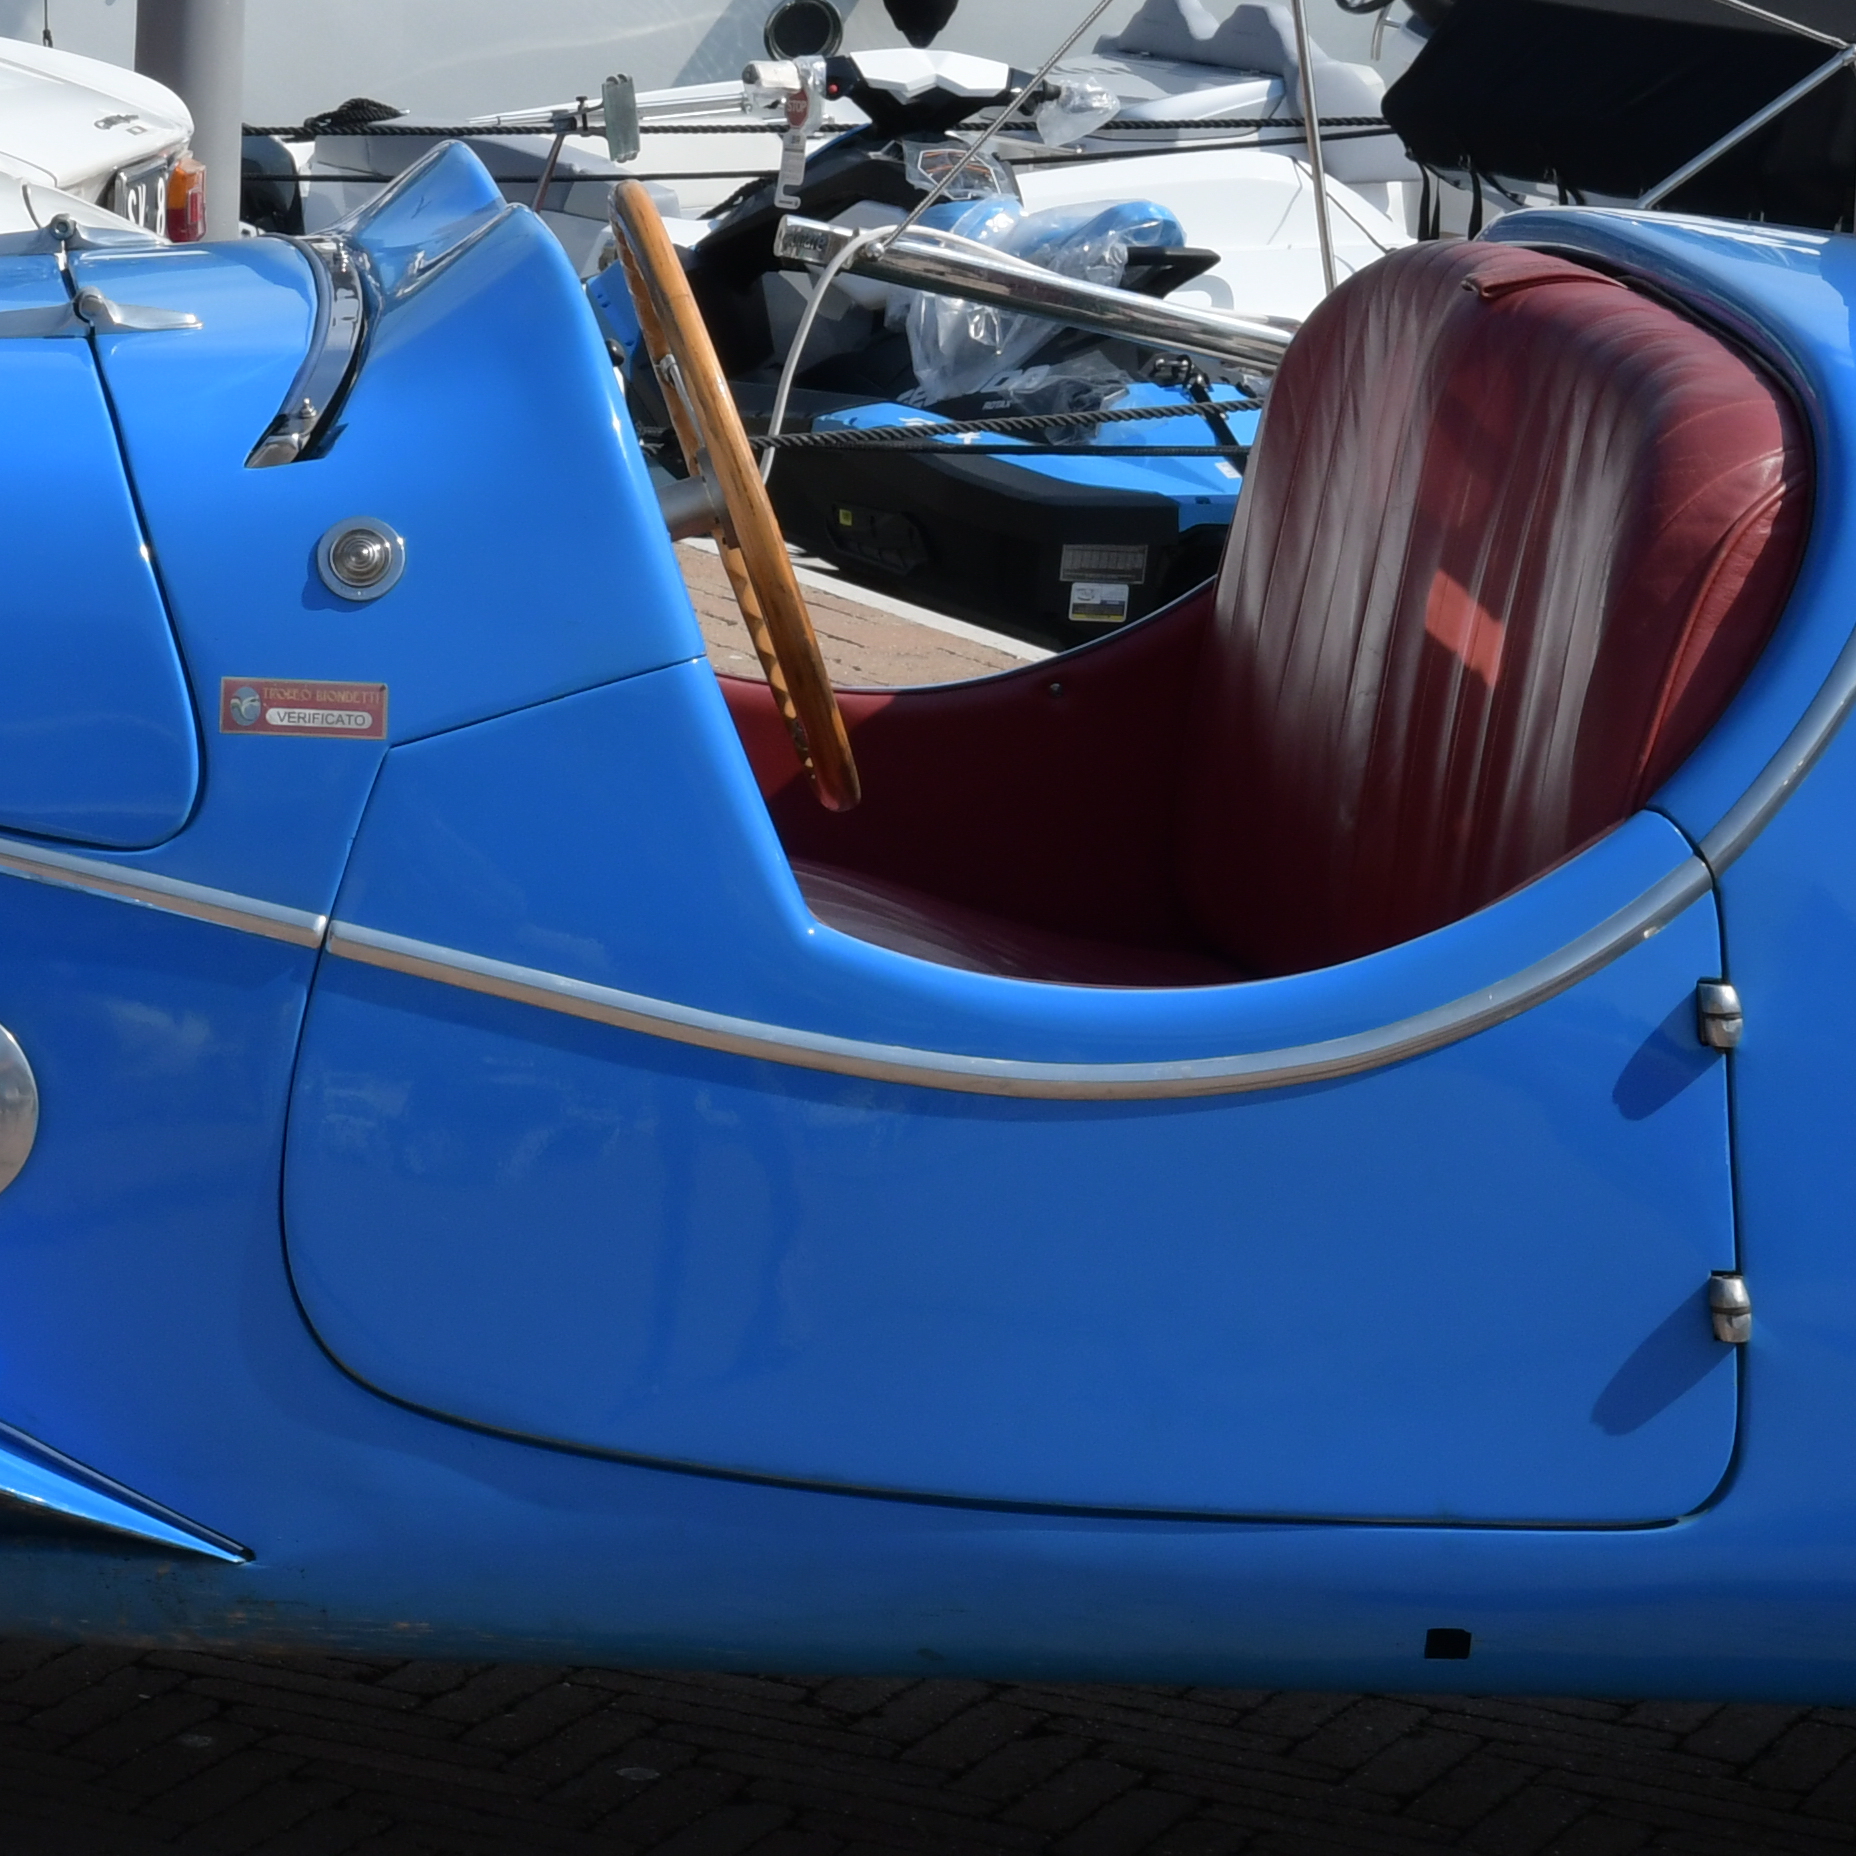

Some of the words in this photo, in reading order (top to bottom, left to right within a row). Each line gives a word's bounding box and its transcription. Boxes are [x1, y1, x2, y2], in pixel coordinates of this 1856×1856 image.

[788, 100, 807, 112] STOP
[315, 690, 381, 704] BIONDETTI
[276, 710, 366, 727] VERIFICATO
